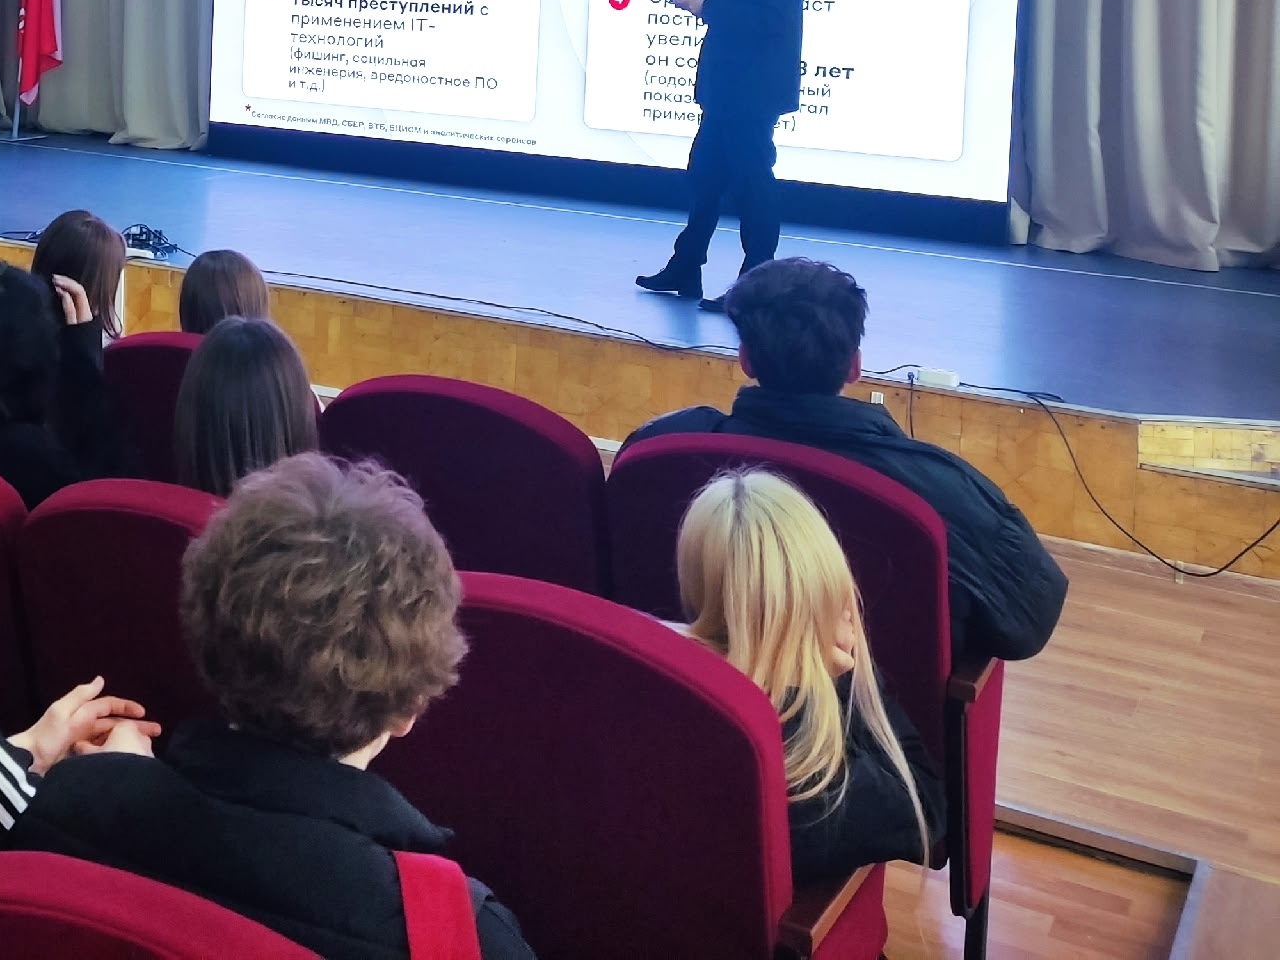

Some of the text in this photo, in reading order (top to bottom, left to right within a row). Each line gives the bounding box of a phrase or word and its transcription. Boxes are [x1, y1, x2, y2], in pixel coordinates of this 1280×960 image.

[349, 0, 474, 15] преступлений
[481, 6, 488, 15] с
[292, 15, 435, 31] применением IT-
[291, 33, 383, 50] технологий
[291, 46, 348, 65] (фишинг,
[646, 55, 668, 66] он
[675, 57, 698, 68] со
[815, 66, 854, 79] лет
[289, 66, 365, 82] инженерия,
[475, 77, 497, 89] ПО
[300, 79, 324, 92] т.д.)
